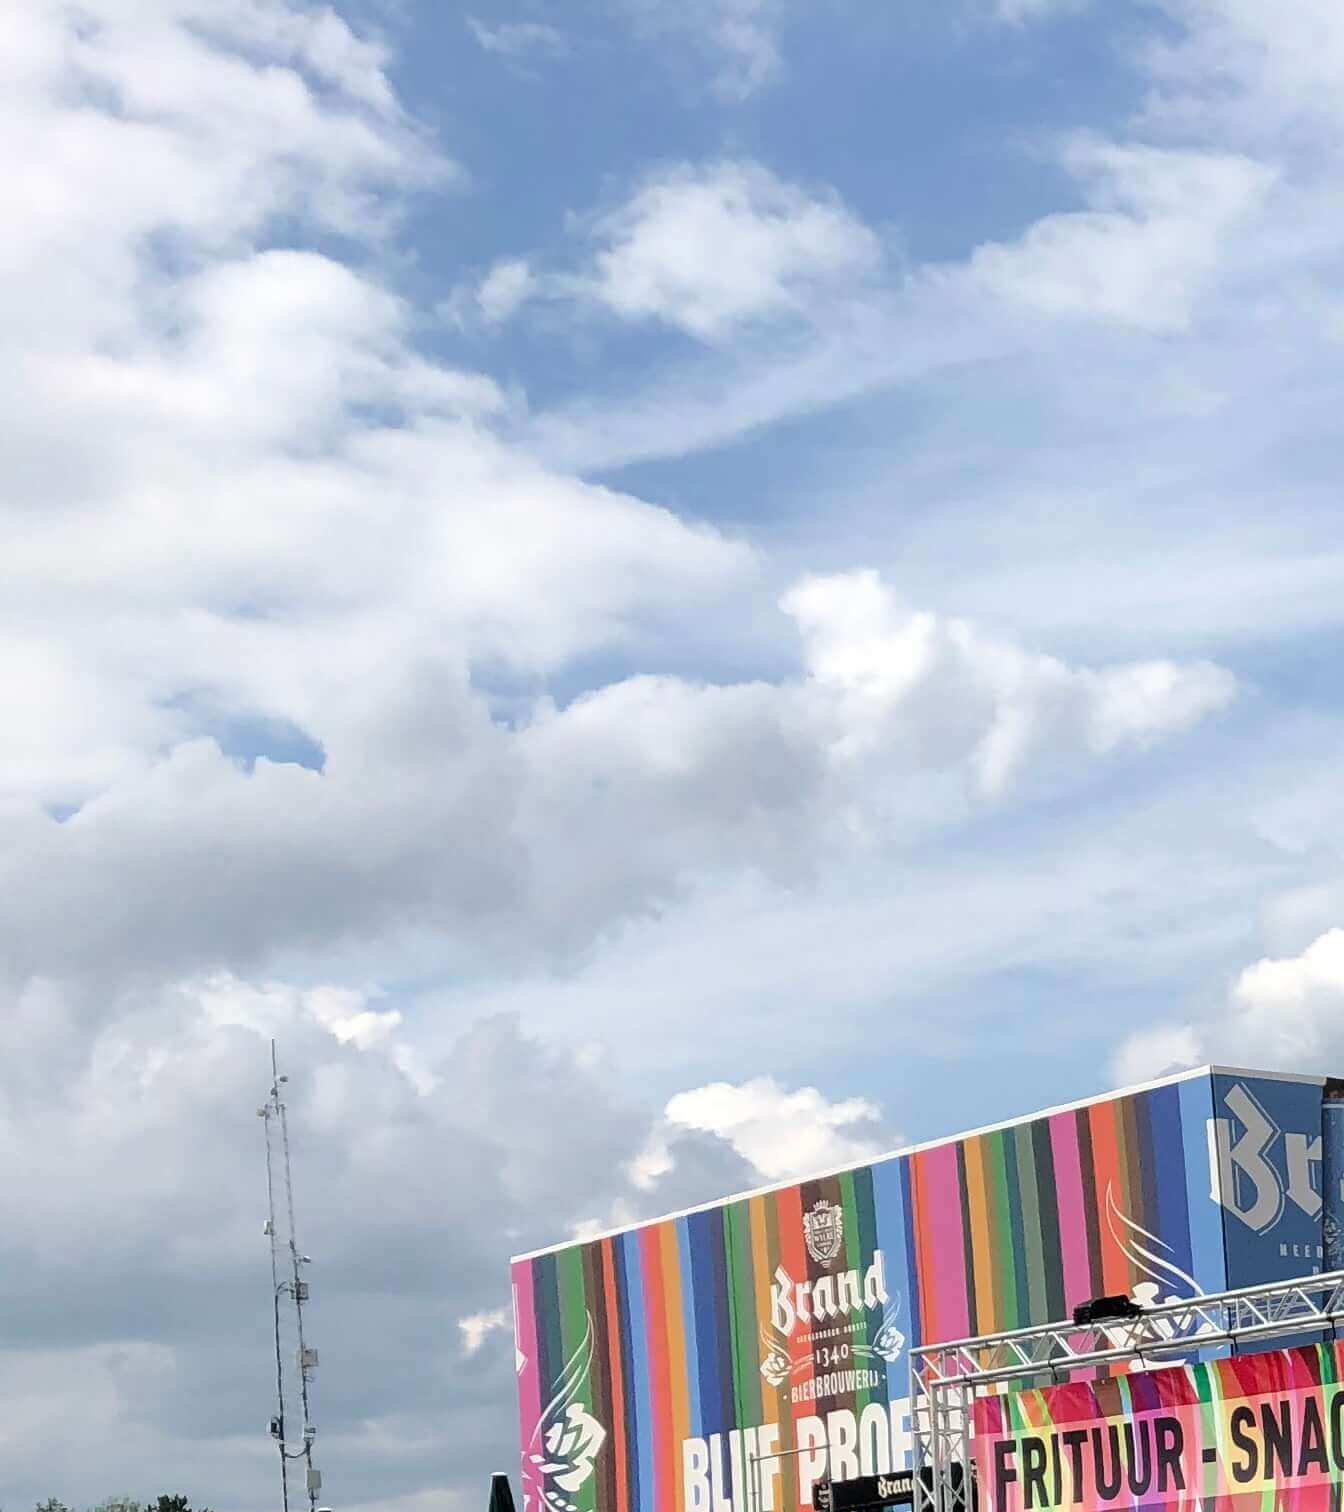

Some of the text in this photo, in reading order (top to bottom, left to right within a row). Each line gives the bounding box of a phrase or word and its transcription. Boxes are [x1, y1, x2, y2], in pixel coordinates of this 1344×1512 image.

[770, 1248, 888, 1336] Brand
[816, 1343, 849, 1367] 1340
[791, 1368, 879, 1404] BIERBROUWERIJ
[993, 1417, 1185, 1512] FRITUUR
[878, 1475, 914, 1498] Bran
